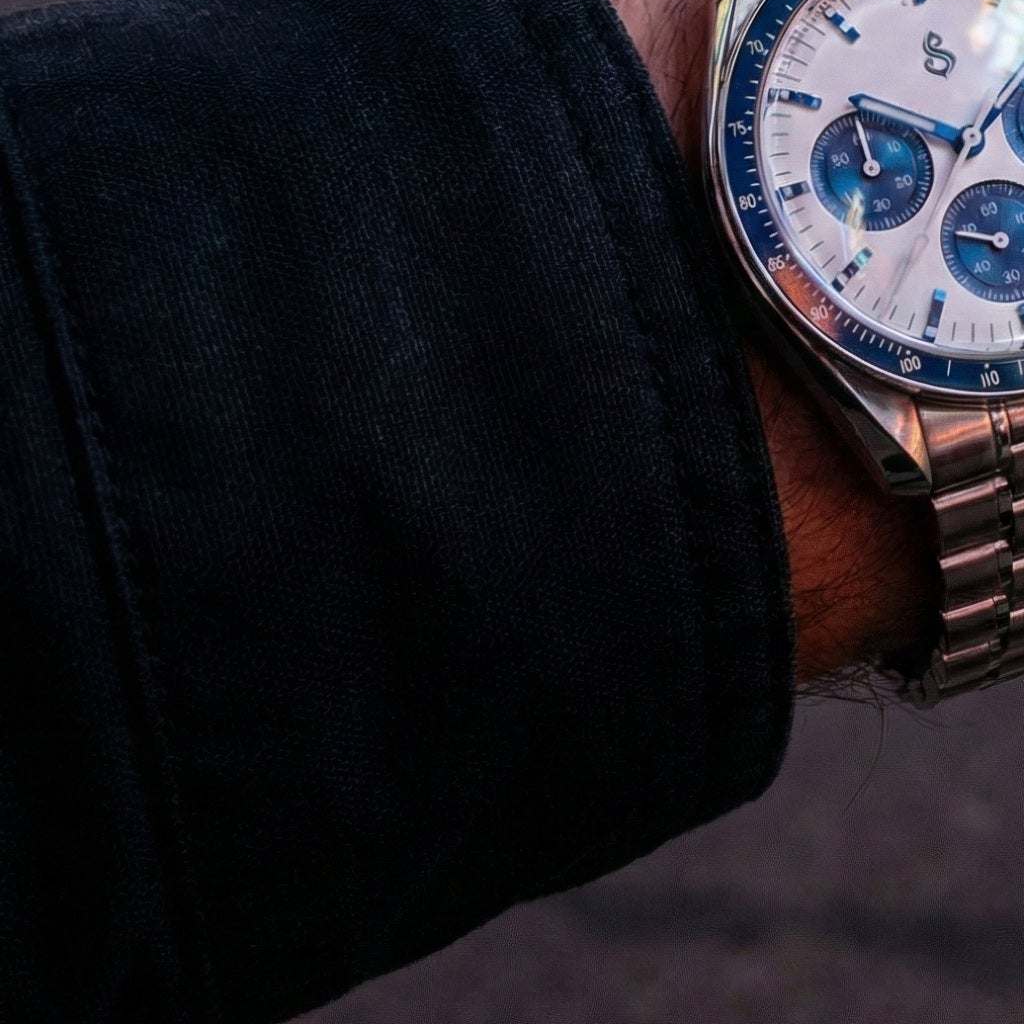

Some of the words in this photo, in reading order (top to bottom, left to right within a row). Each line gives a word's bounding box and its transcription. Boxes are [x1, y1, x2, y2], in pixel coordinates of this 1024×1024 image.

[747, 39, 764, 56] 70
[728, 119, 747, 139] 75
[739, 193, 757, 211] 80
[900, 355, 921, 374] 100
[980, 370, 1000, 388] 110
